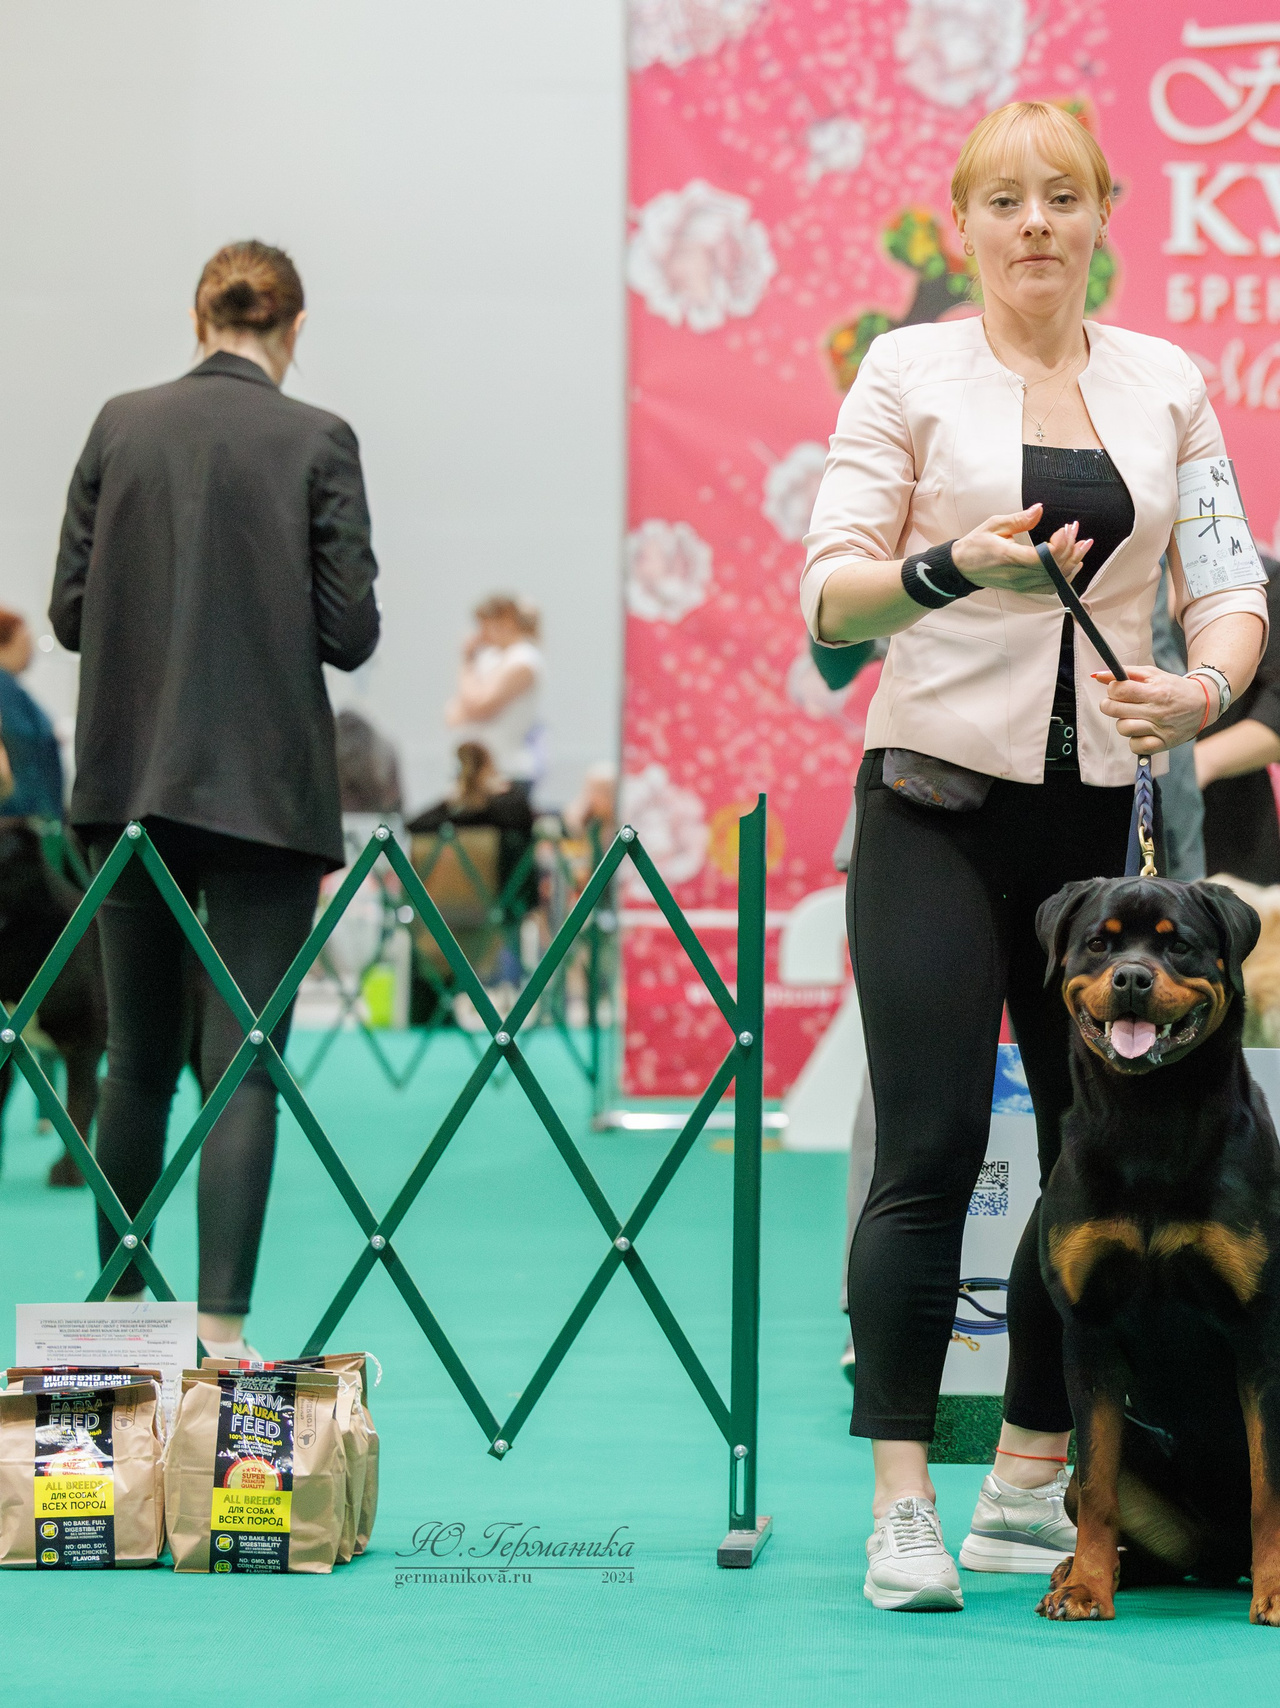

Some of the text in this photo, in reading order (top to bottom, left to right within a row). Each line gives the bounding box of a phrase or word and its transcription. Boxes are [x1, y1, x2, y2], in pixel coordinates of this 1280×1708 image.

[233, 1388, 283, 1411] FARM
[232, 1402, 281, 1422] NATURAL
[49, 1413, 100, 1430] FEED
[231, 1413, 281, 1438] FEED
[45, 1482, 62, 1491] ALL
[51, 1491, 98, 1500] ДЛЯ СОБАК
[223, 1494, 281, 1505] ALL BREEDS
[42, 1500, 106, 1511] ВСЕХ ПОРОД
[228, 1506, 275, 1515] ДЛЯ СОБАК
[218, 1515, 284, 1527] ВСЕХ ПОРОД
